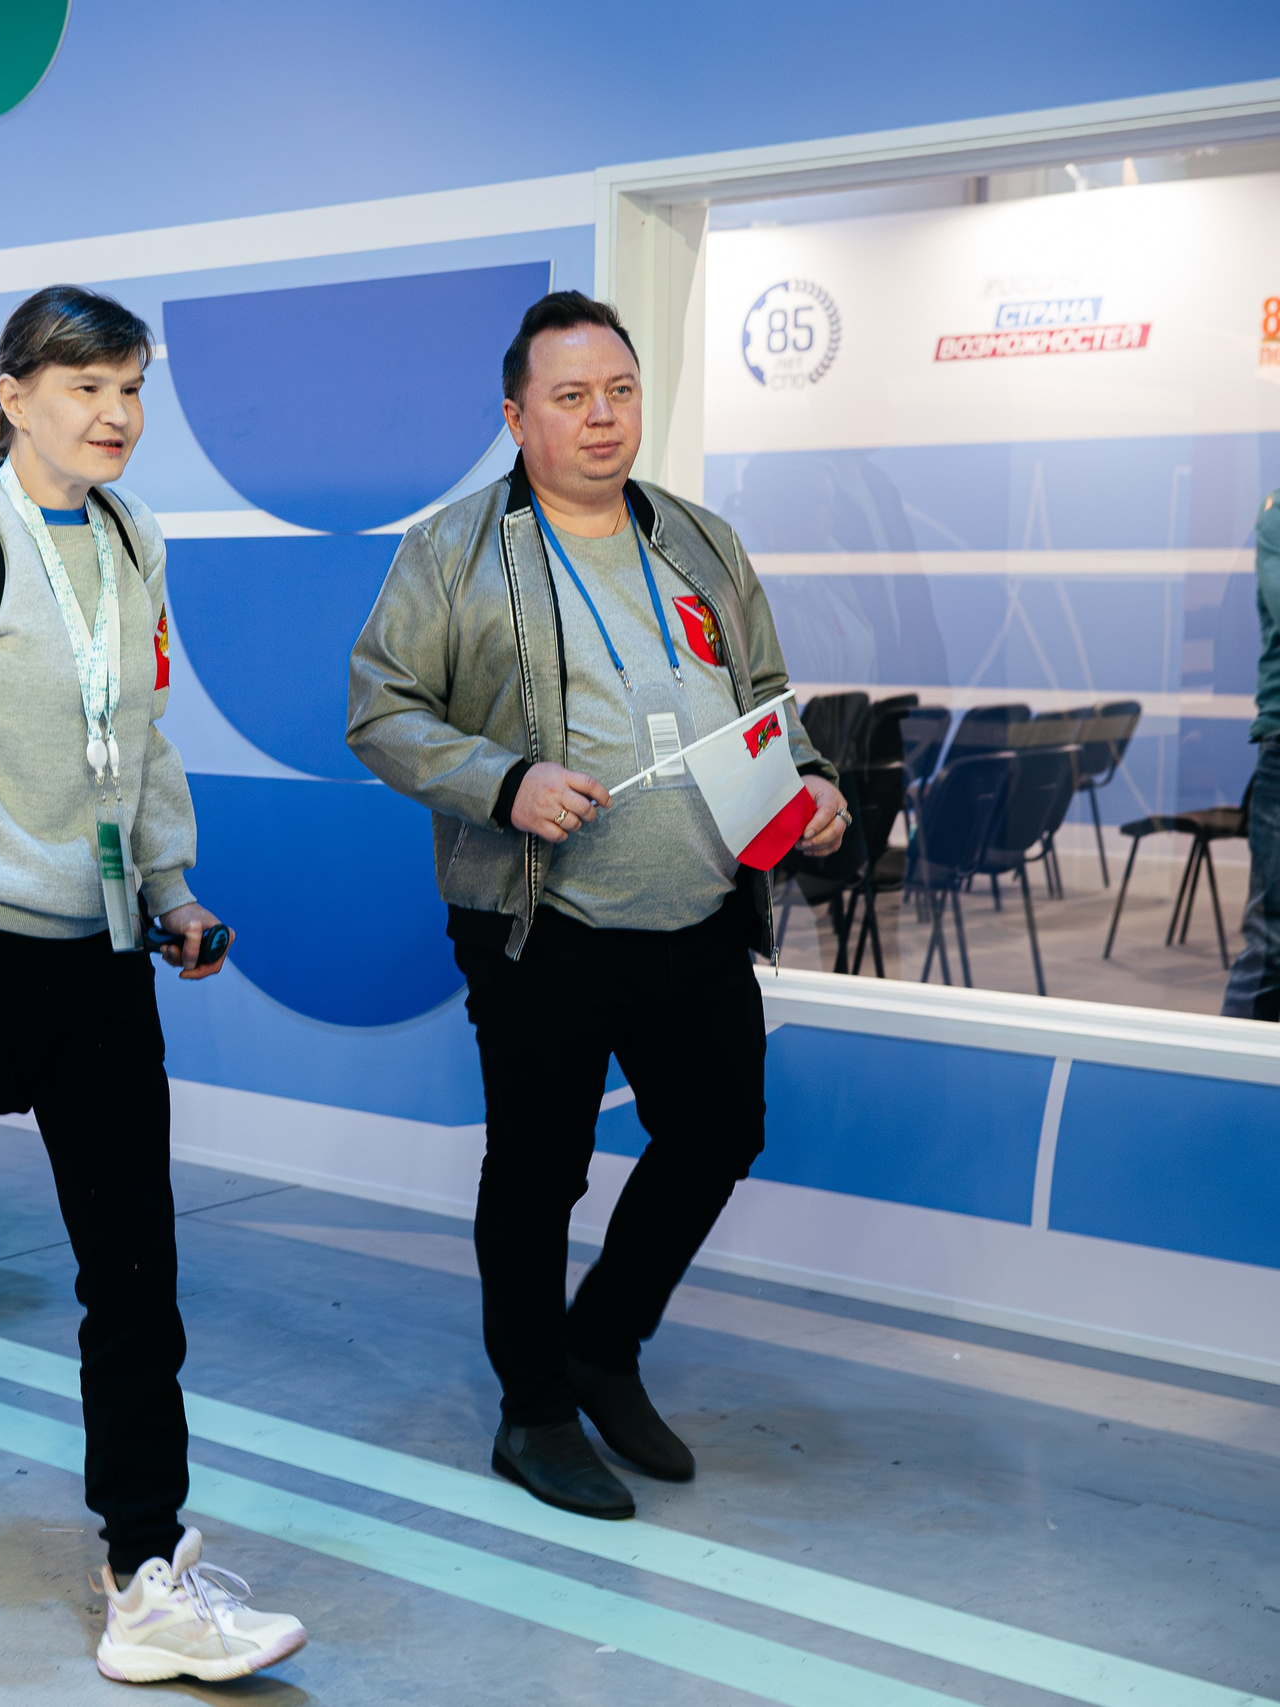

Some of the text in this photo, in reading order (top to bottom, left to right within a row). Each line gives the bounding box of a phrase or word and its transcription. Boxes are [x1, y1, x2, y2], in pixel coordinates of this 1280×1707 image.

[767, 306, 814, 353] 85
[999, 299, 1095, 327] СТРАНА
[938, 323, 1143, 360] ВОЗМОЖНОСТЕЙ
